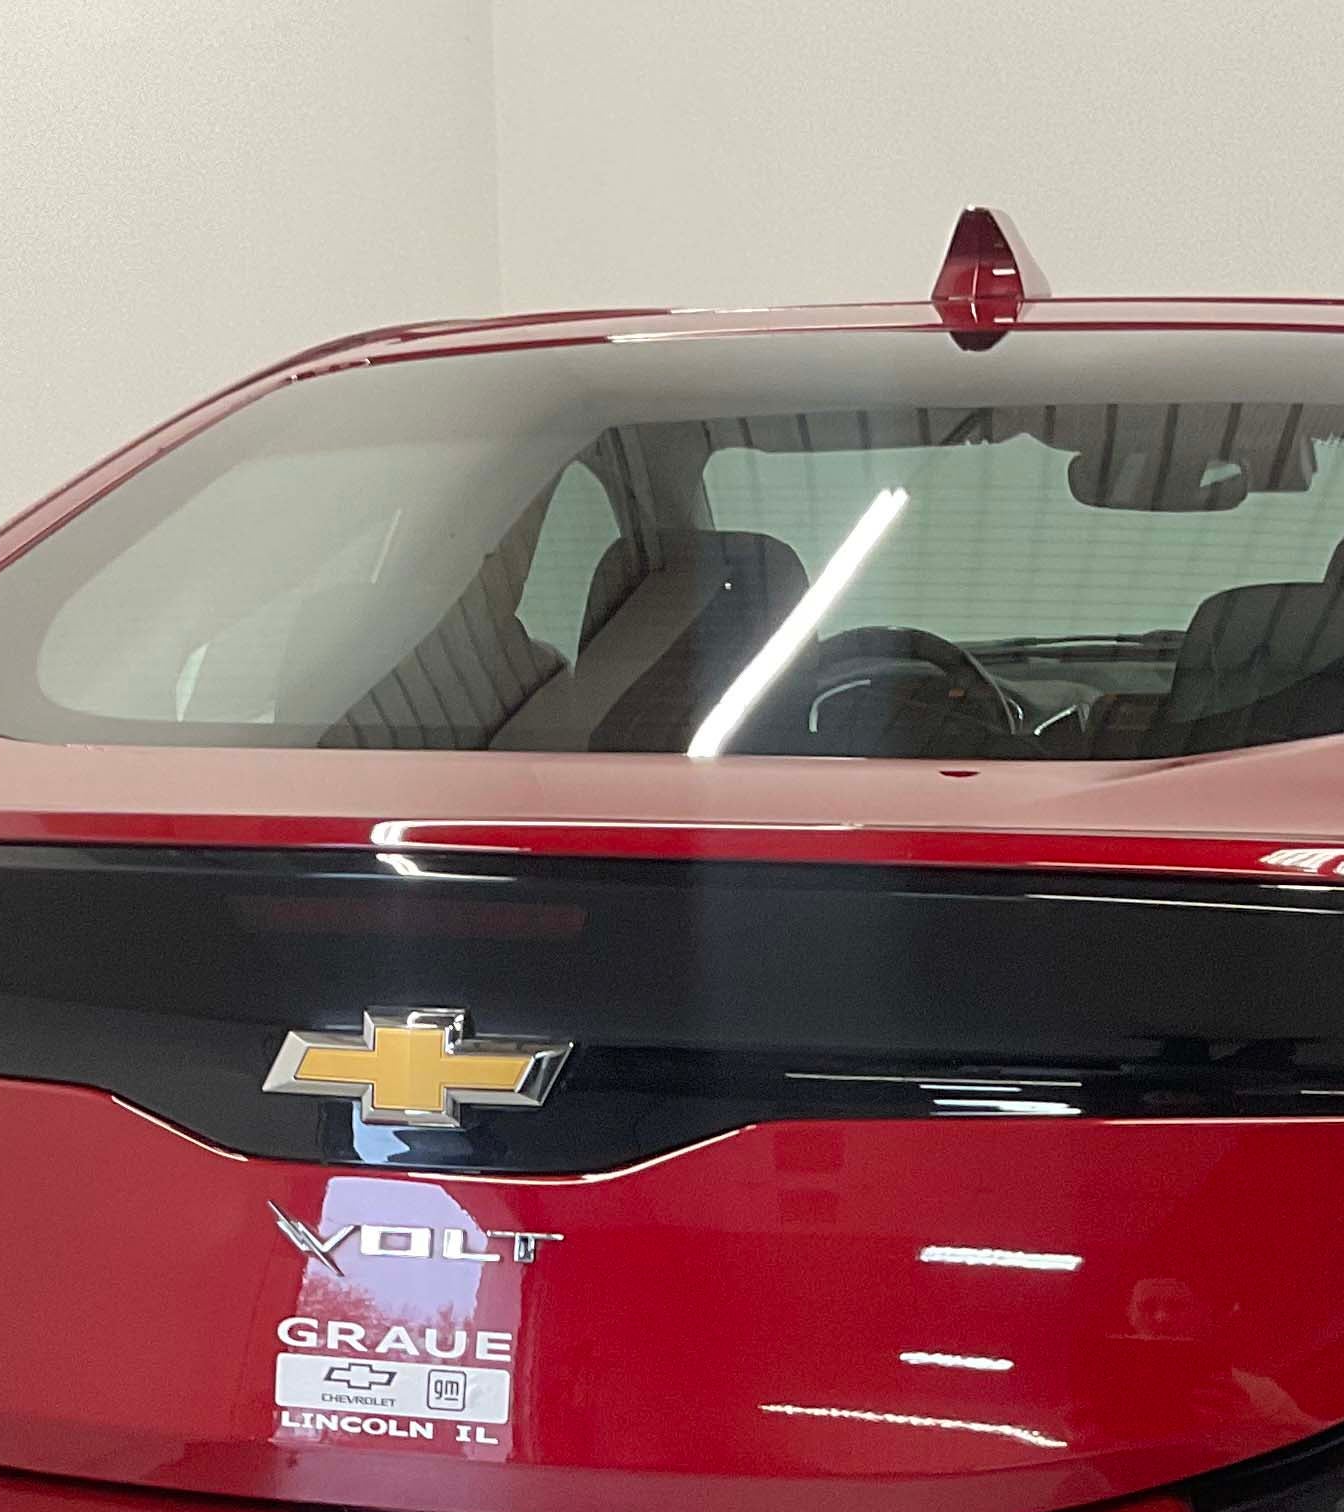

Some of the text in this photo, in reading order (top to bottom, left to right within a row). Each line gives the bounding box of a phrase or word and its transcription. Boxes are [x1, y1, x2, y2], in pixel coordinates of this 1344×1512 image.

[266, 1199, 566, 1277] VOLT
[276, 1316, 514, 1363] GRAUE
[320, 1392, 397, 1408] CHEVROLET
[434, 1378, 460, 1402] gm
[280, 1410, 500, 1445] LINCOLN IL
